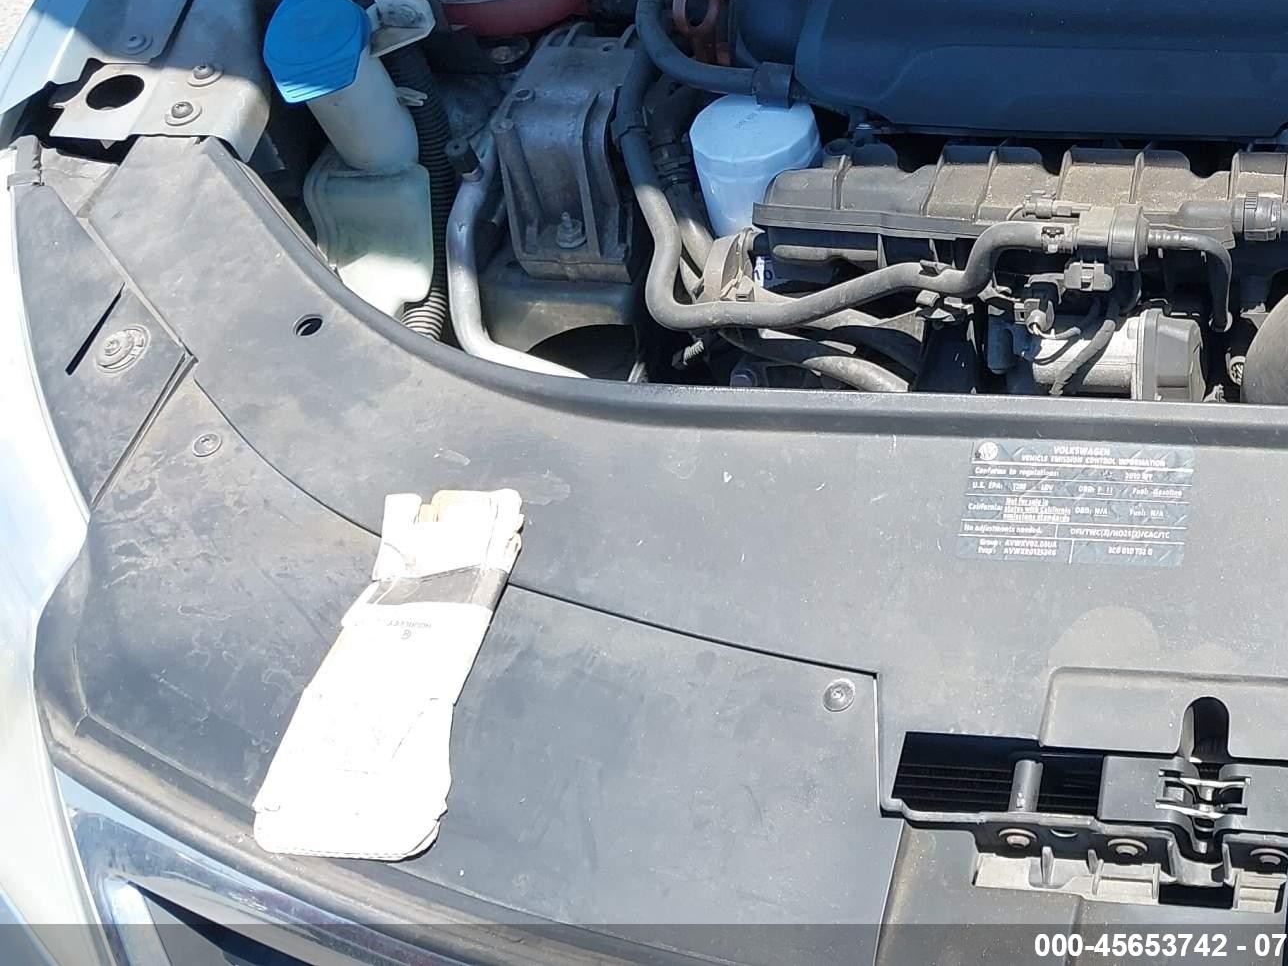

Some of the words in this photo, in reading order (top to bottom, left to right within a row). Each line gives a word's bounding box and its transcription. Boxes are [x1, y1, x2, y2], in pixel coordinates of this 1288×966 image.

[1053, 445, 1111, 456] VOLKSWAGEN
[1021, 454, 1048, 463] VEHICLE
[1051, 455, 1083, 464] EMISSION
[1085, 456, 1116, 465] CONTROL
[1118, 457, 1166, 467] INFORMATION
[974, 466, 1007, 476] Conforms
[1008, 468, 1018, 476] to
[968, 502, 1003, 512] California:
[1040, 506, 1071, 515] California
[1094, 507, 1108, 516] N/A
[1150, 509, 1164, 518] N/A
[964, 523, 974, 532] No
[975, 524, 1016, 534] adjustments
